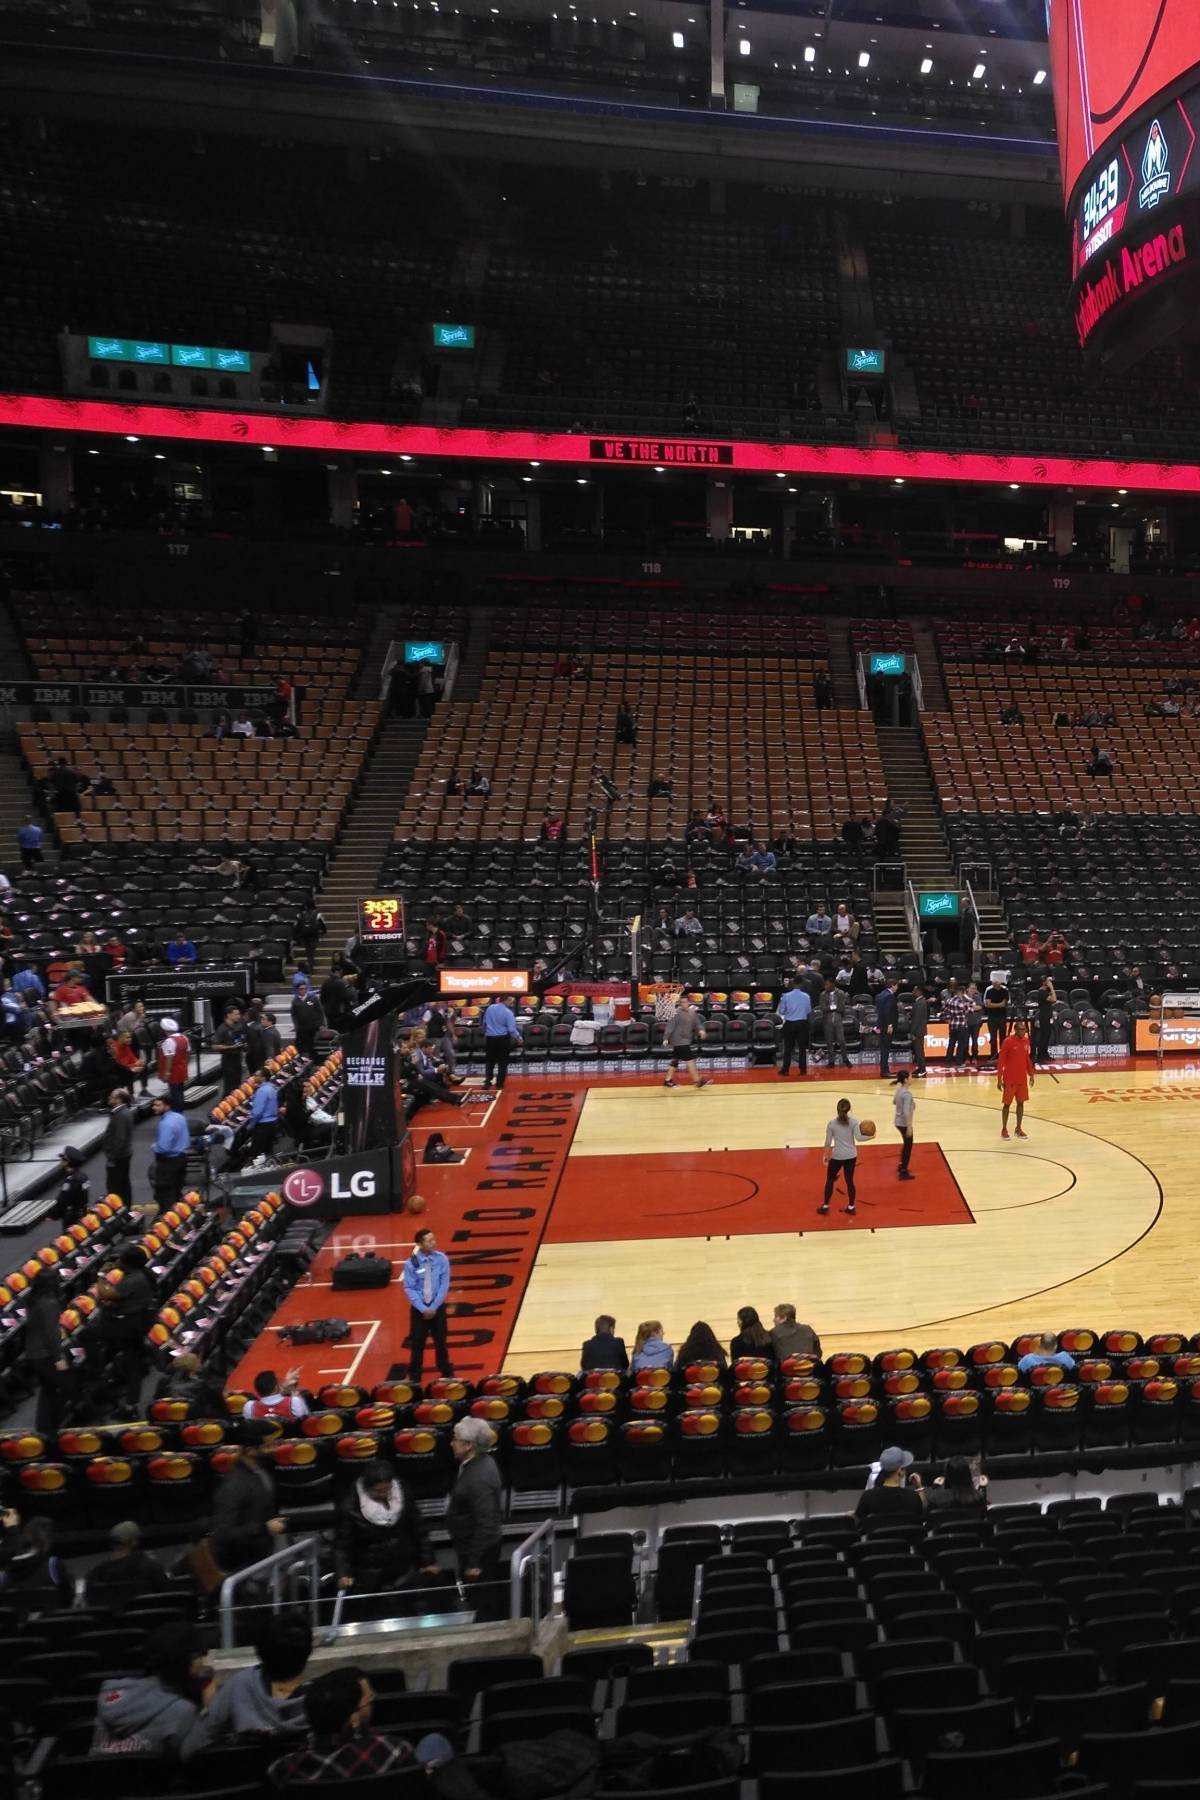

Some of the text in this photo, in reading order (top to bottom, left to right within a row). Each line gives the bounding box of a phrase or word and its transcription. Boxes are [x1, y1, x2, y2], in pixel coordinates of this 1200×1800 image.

[1083, 158, 1119, 240] 34:29
[1121, 224, 1186, 293] Arena
[605, 442, 719, 463] WE THE NORTH
[642, 562, 662, 574] 118
[1052, 578, 1071, 589] 119
[877, 657, 900, 672] Sprite
[34, 689, 71, 703] IBM
[88, 690, 124, 703] IBM
[141, 691, 177, 705] IBM
[193, 692, 229, 705] IBM
[926, 897, 953, 913] Sprite
[371, 913, 393, 929] 23
[446, 976, 497, 988] Tangerine
[346, 1057, 386, 1066] RECHARGE
[347, 1072, 385, 1084] MILK
[475, 1089, 576, 1191] RAPTORS
[330, 1171, 376, 1199] LG
